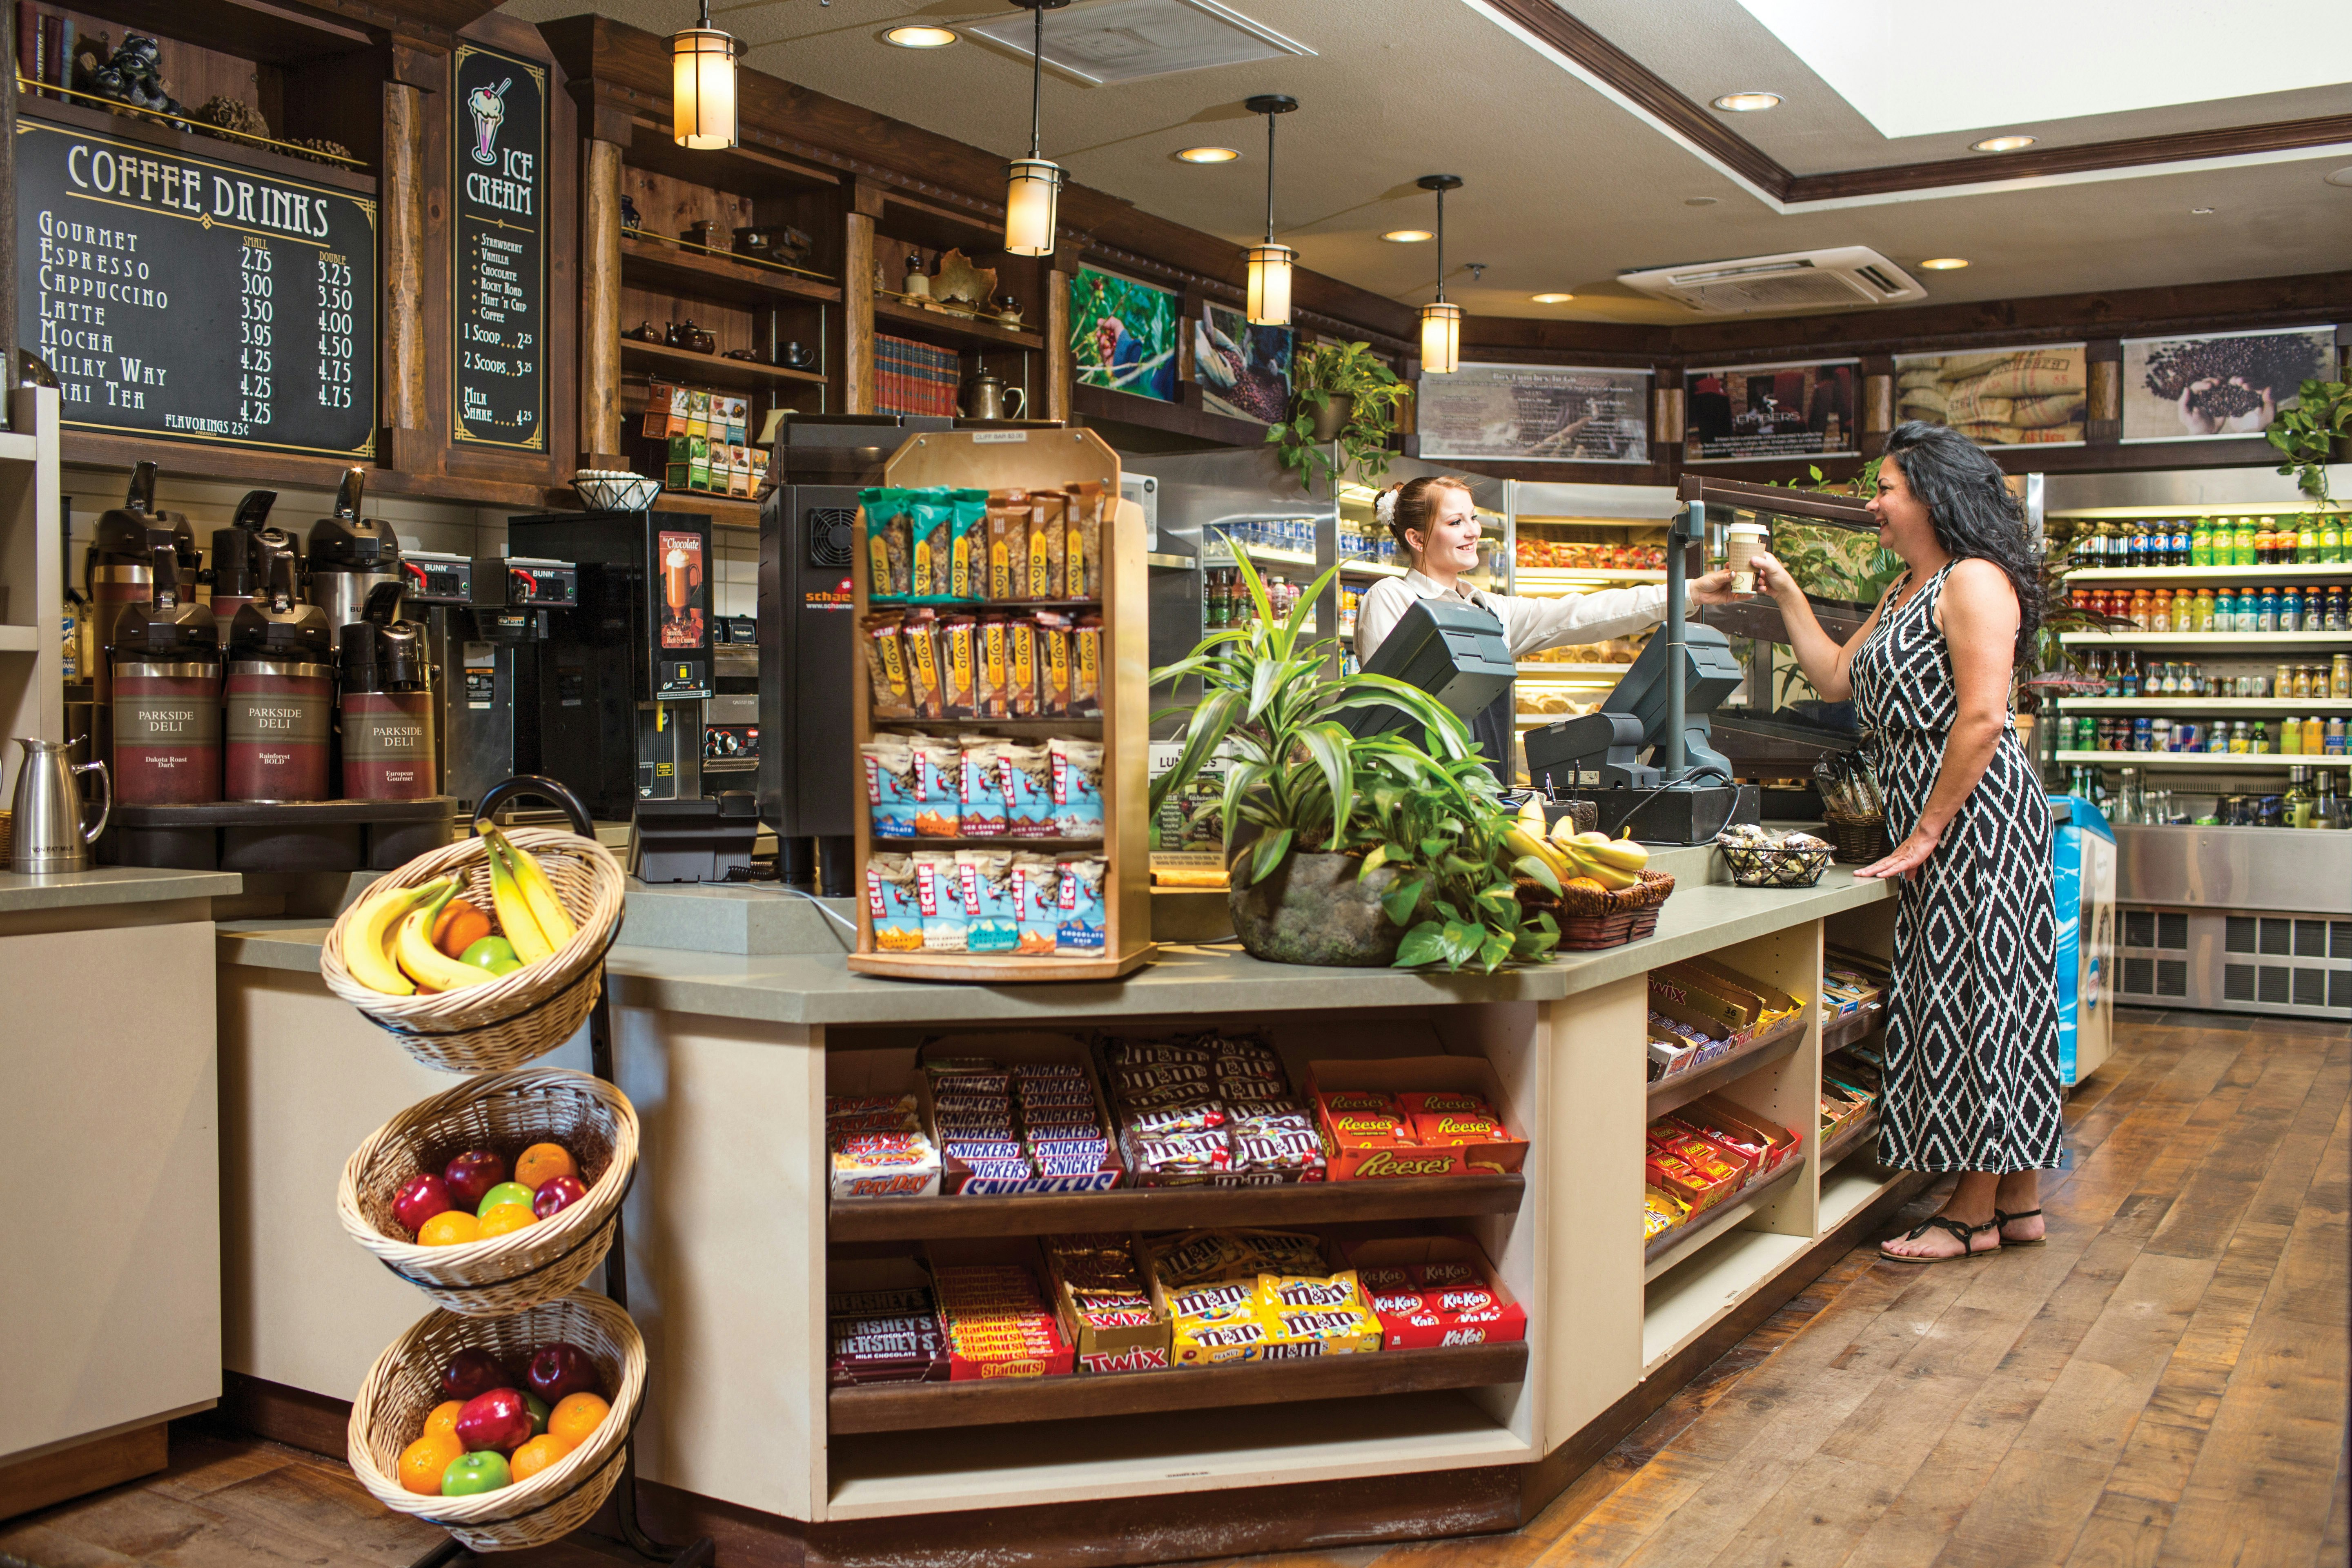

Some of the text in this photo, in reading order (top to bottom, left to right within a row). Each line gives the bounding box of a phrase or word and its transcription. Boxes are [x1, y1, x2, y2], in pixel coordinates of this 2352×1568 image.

[503, 147, 533, 184] ICE
[69, 146, 327, 237] COFFEE DRINKS
[466, 172, 532, 215] CREAM
[39, 211, 351, 286] GOURMET 2.75 3.25
[243, 236, 268, 250] SMALL
[481, 233, 523, 254] STRAWBERRY
[320, 251, 346, 265] DOUBLE
[481, 247, 510, 265] VANILLA
[40, 237, 352, 311] ESPRESSO 3.00 3.50
[481, 263, 517, 282] CHOCOLATE
[481, 277, 523, 297] ROCKY ROAD
[40, 265, 352, 335] CAPPUCCINO 3.50 4.00
[481, 292, 499, 307] MINT
[511, 298, 527, 312] CHIP
[481, 306, 505, 323] COFFEE
[40, 291, 352, 359] LATTE 3.95 4.50
[464, 323, 469, 339] 1
[472, 324, 501, 344] SCOOP
[40, 318, 351, 383] MOCHA 4.25 4.75
[464, 351, 471, 368] 2
[474, 353, 506, 374] SCOOPS
[120, 356, 167, 386] WAY
[241, 374, 271, 398] 4.25
[318, 384, 351, 408] 4.75
[60, 381, 271, 424] HAI TEA 4.25
[464, 386, 487, 405] MILK
[464, 402, 492, 423] SHAKE
[1736, 411, 1801, 425] EMBERS
[165, 414, 249, 436] FLAVORINGS 25¢
[667, 537, 699, 549] Chocolate
[424, 564, 446, 572] BUNN
[806, 591, 851, 601] schae
[139, 711, 194, 720] PARKSIDE
[249, 708, 302, 718] PARKSIDE
[150, 722, 182, 731] DELI
[259, 718, 290, 728] DELI
[373, 727, 422, 736] PARKSIDE
[385, 737, 413, 746] DELI
[867, 871, 884, 909] CLIF
[919, 865, 935, 905] CLIF
[960, 865, 977, 904] CLIF
[1724, 1007, 1737, 1016] 36
[942, 1127, 1010, 1139] SNICKERS
[1031, 1125, 1100, 1139] SNICKERS
[1338, 1116, 1393, 1131] Reese's
[1438, 1117, 1491, 1134] Reese's
[948, 1143, 1018, 1158] SNICKERS
[1038, 1138, 1105, 1156] SNICKERS
[1681, 1142, 1704, 1155] Reese's
[968, 1164, 1029, 1179] NICKERS
[1354, 1151, 1457, 1177] Reese's
[1656, 1157, 1679, 1167] Reese's
[1706, 1164, 1728, 1177] Reese's
[850, 1173, 935, 1196] PayDay
[833, 1316, 933, 1337] HERSHEY'S
[834, 1334, 935, 1355] HERSHEY'S
[874, 1351, 917, 1359] CHOCOLATE
[1080, 1345, 1169, 1372] Twix
[1214, 1349, 1240, 1360] PEANUT
[982, 1359, 1046, 1378] Starburst
